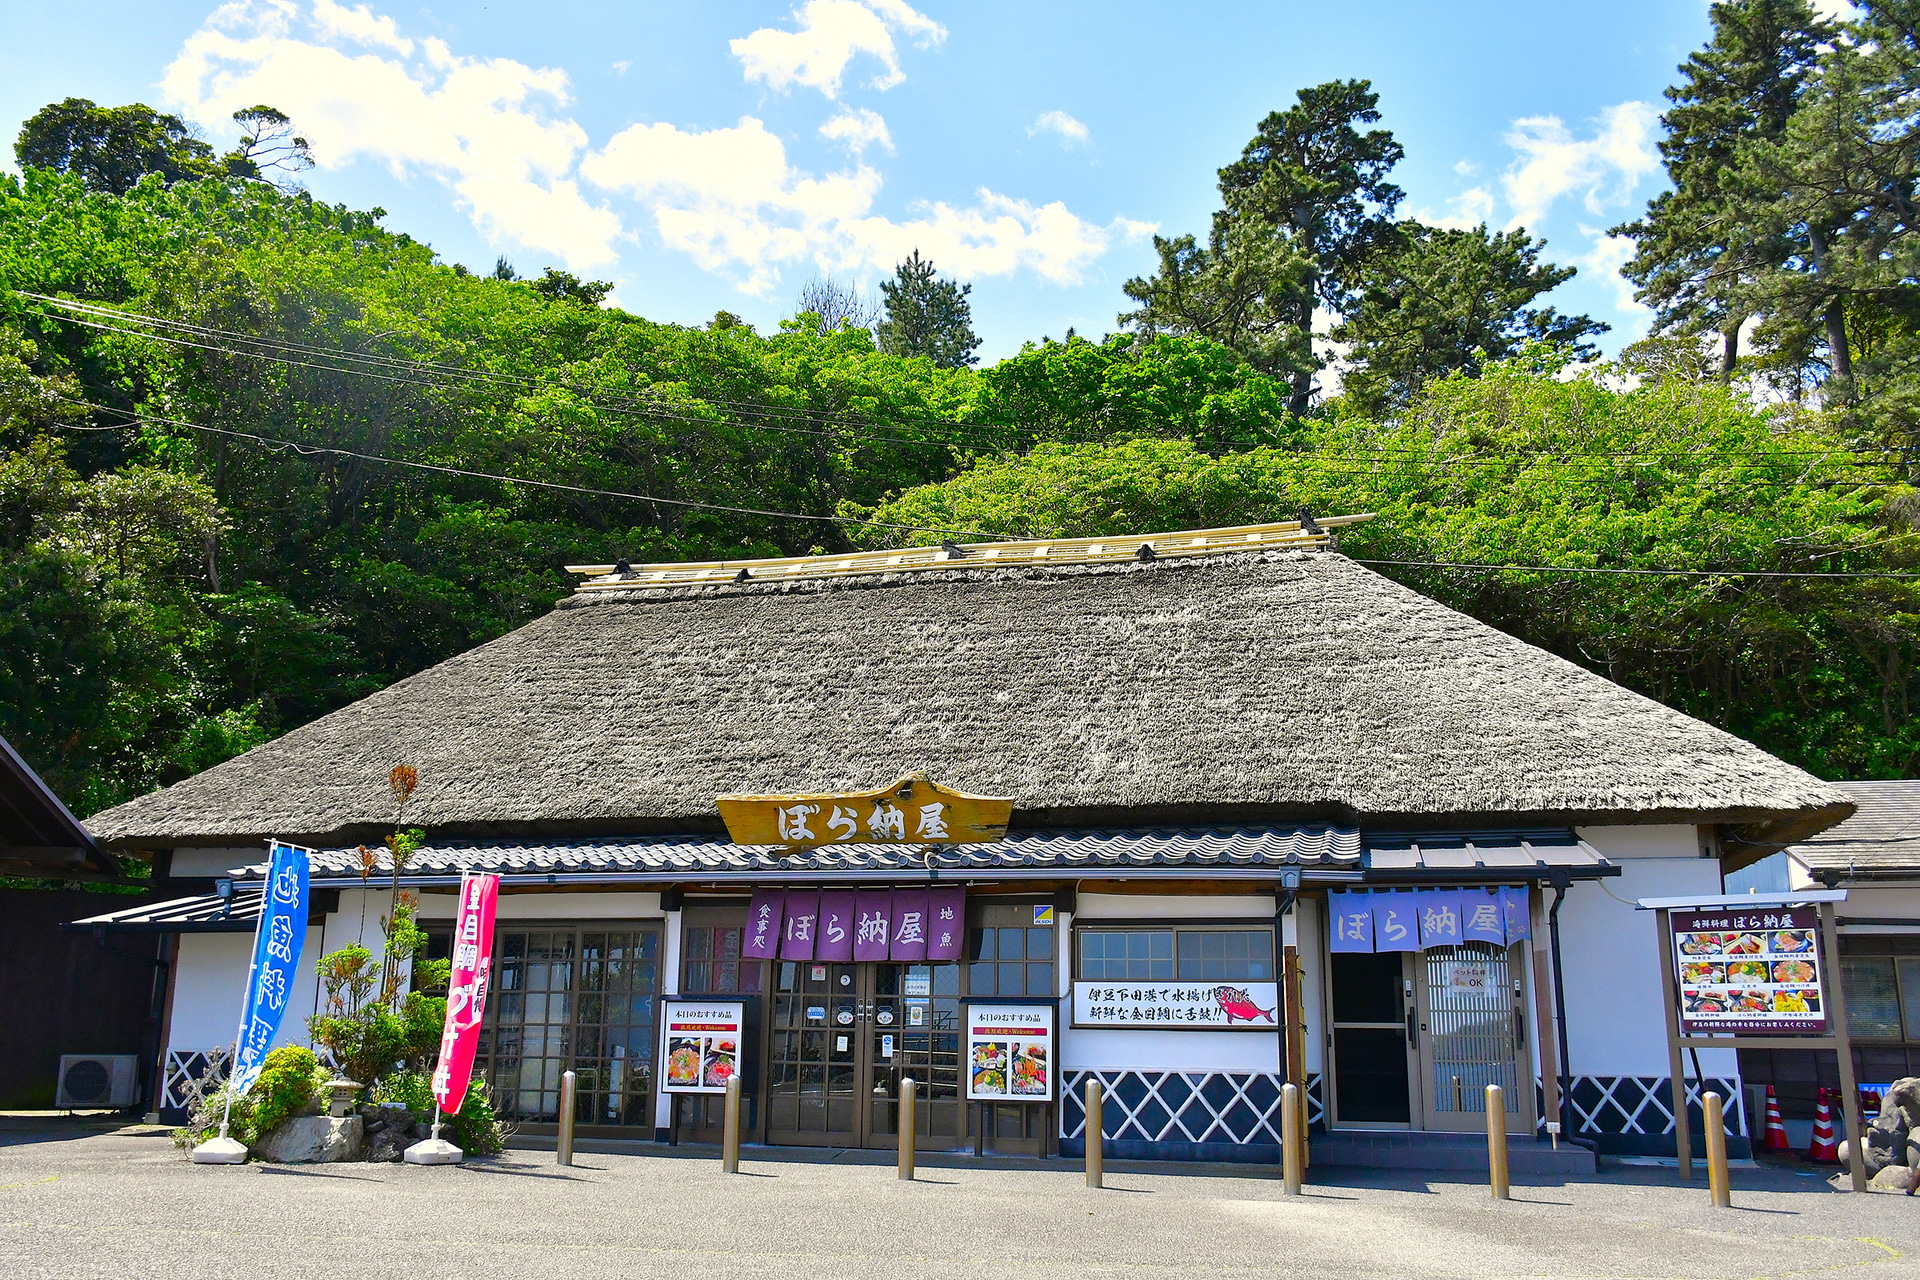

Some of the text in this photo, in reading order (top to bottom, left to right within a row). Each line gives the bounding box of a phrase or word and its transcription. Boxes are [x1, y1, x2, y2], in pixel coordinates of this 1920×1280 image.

[777, 801, 950, 841] ぼら納屋
[751, 903, 771, 949] 食事処
[787, 911, 926, 946] ぼら納屋
[940, 906, 953, 948] 地魚
[1338, 904, 1502, 942] ぼら納屋
[1692, 913, 1795, 929] 海鮮料理 ぼら納屋
[1088, 987, 1250, 1003] 伊豆下田港で水揚げされた
[1469, 979, 1483, 987] OK
[675, 1009, 733, 1019] 本日のおすすめ品
[978, 1013, 1041, 1023] 本日のおすすめ品
